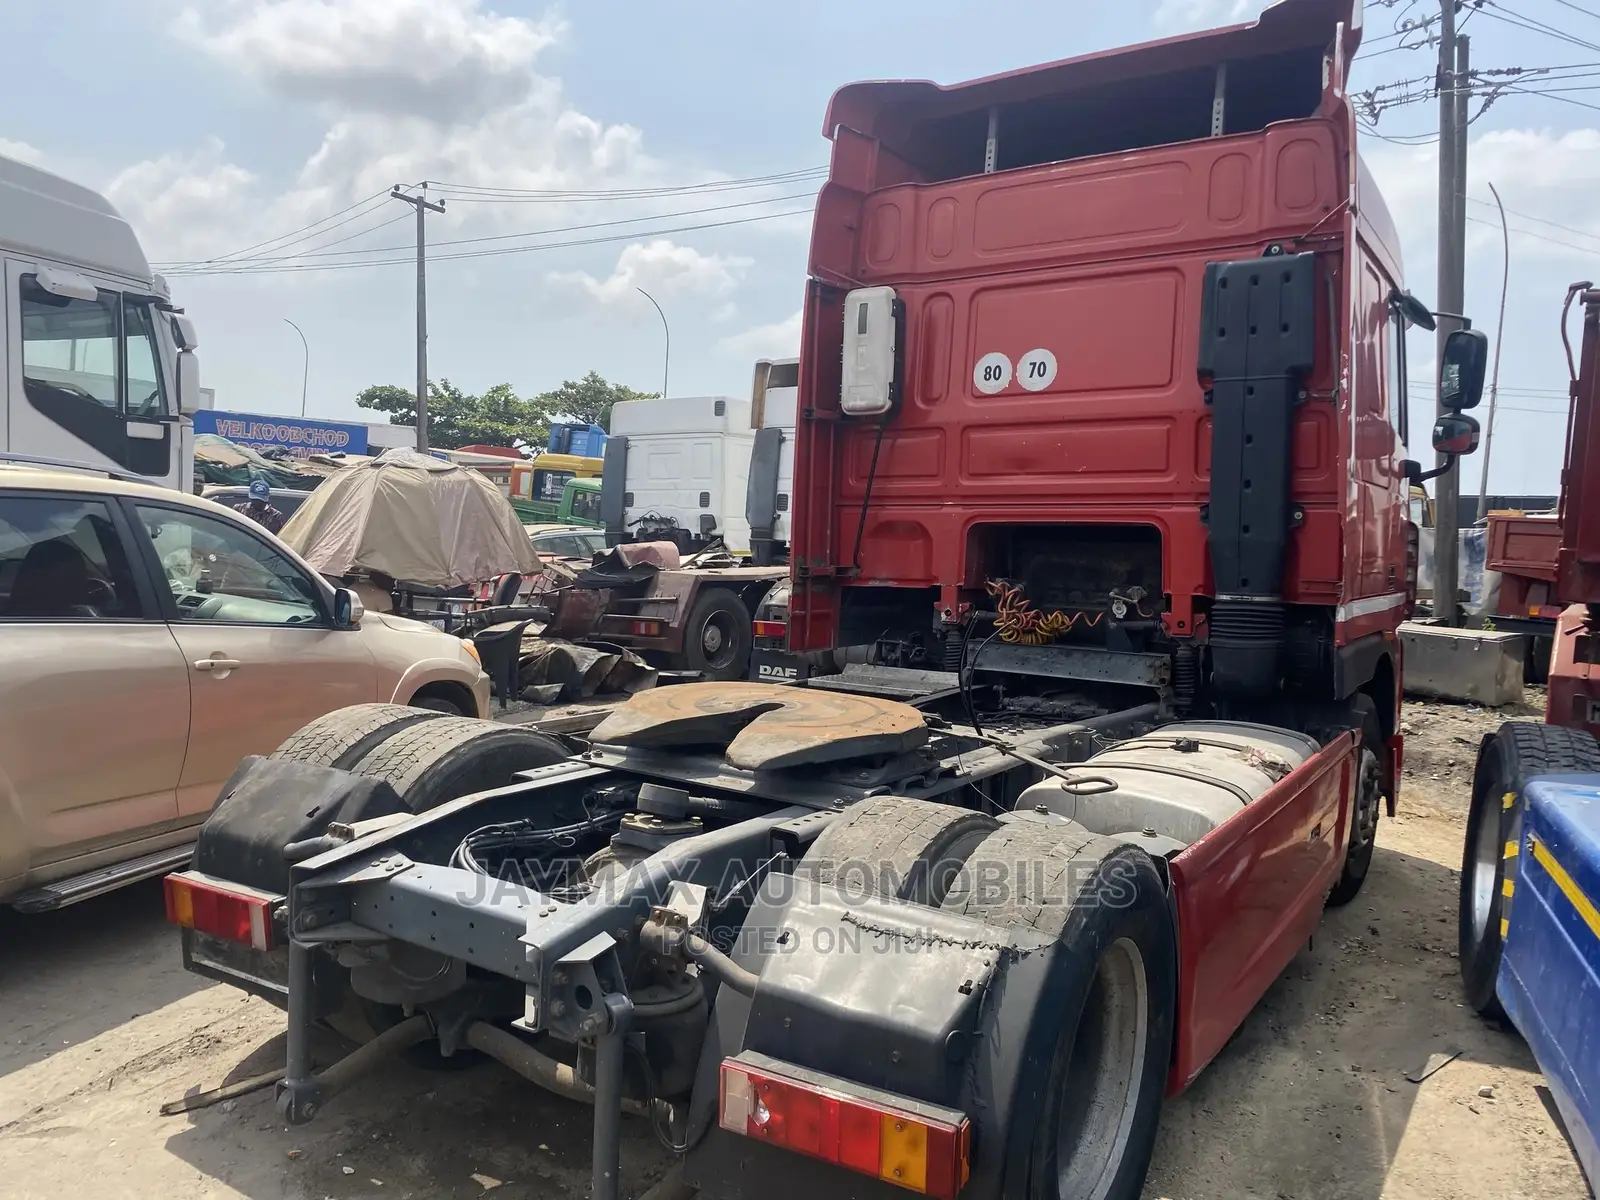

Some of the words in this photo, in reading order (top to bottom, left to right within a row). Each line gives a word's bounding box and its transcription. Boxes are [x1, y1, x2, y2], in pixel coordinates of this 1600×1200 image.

[983, 365, 1002, 381] 80
[1028, 361, 1047, 378] 70
[216, 419, 349, 447] VELKOOBCHOD
[759, 664, 798, 678] DAF
